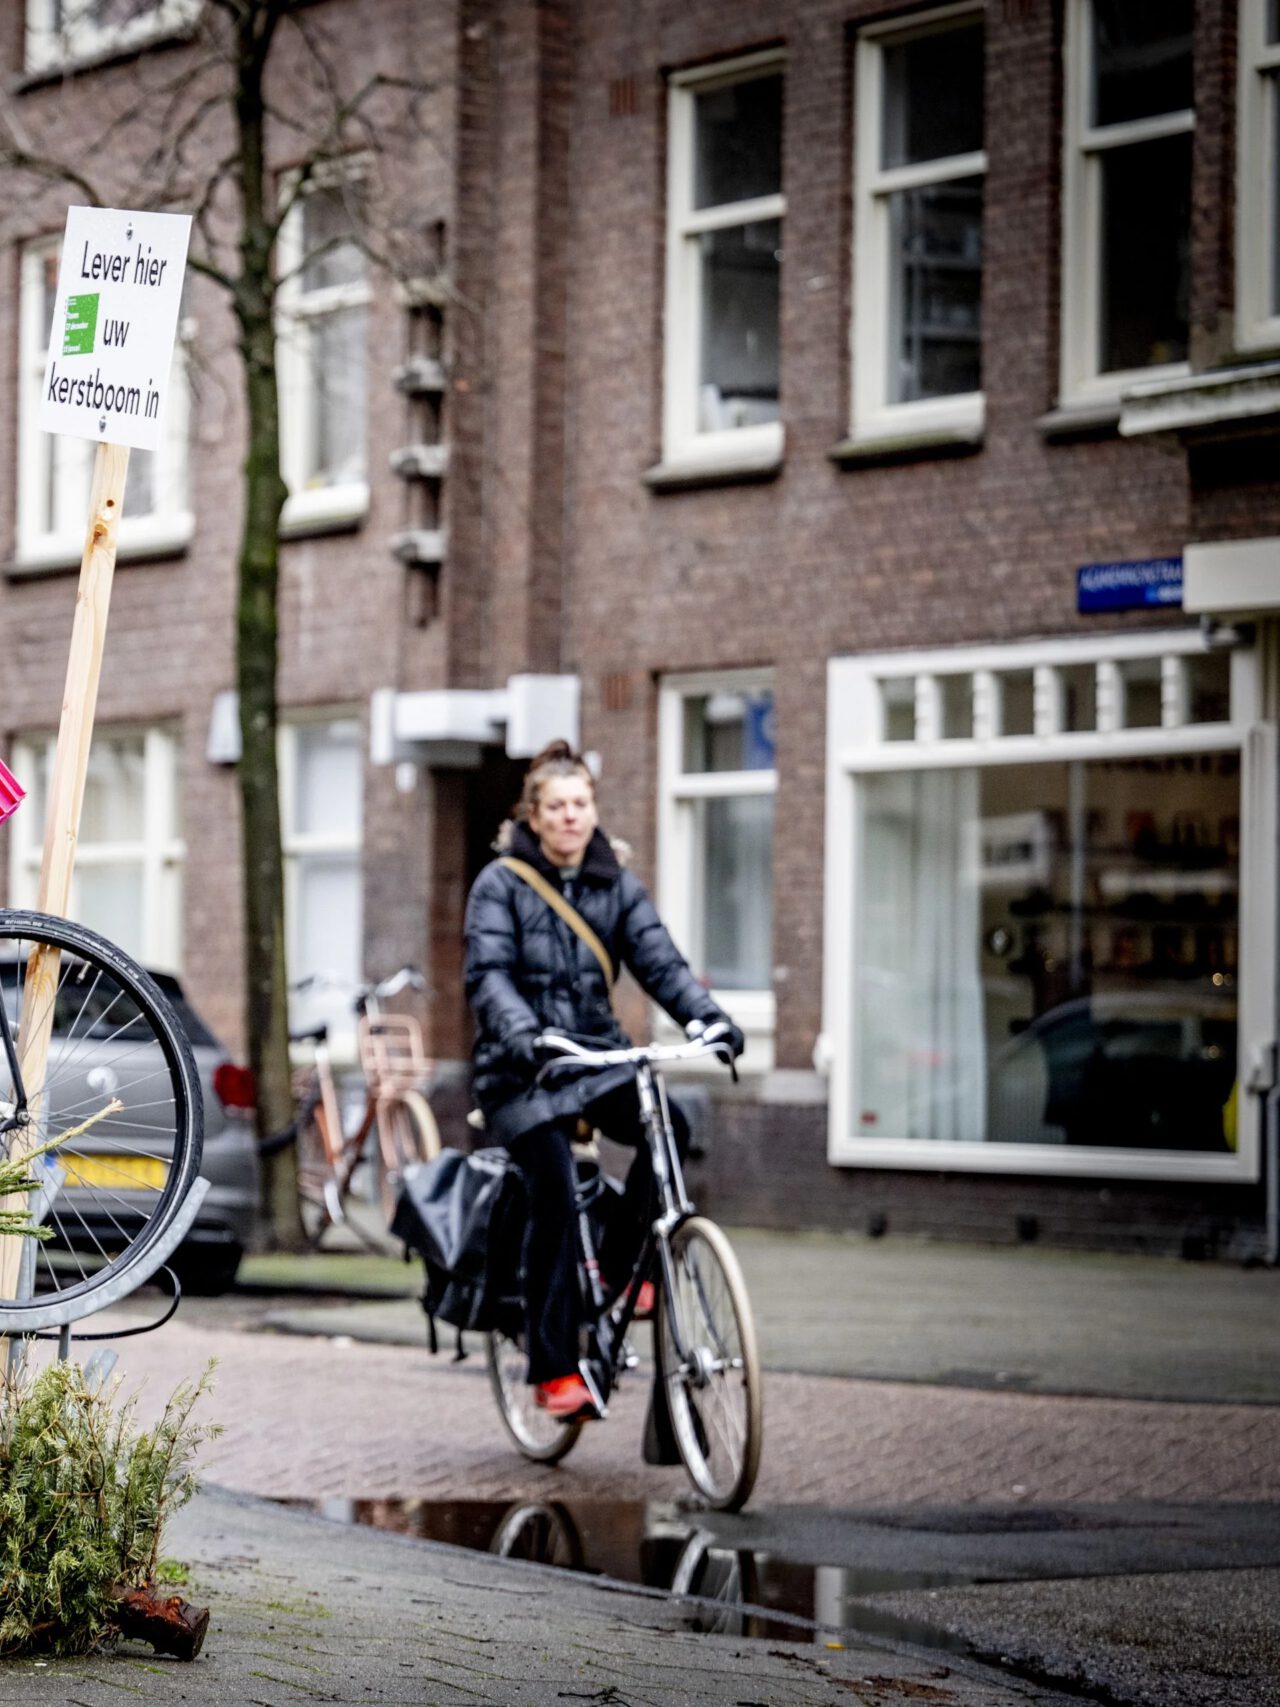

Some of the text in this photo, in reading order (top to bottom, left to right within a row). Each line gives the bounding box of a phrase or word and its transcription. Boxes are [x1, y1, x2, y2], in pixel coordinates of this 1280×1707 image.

[81, 240, 167, 287] Lever hier
[103, 319, 130, 348] uw
[47, 361, 160, 419] kerstboom in
